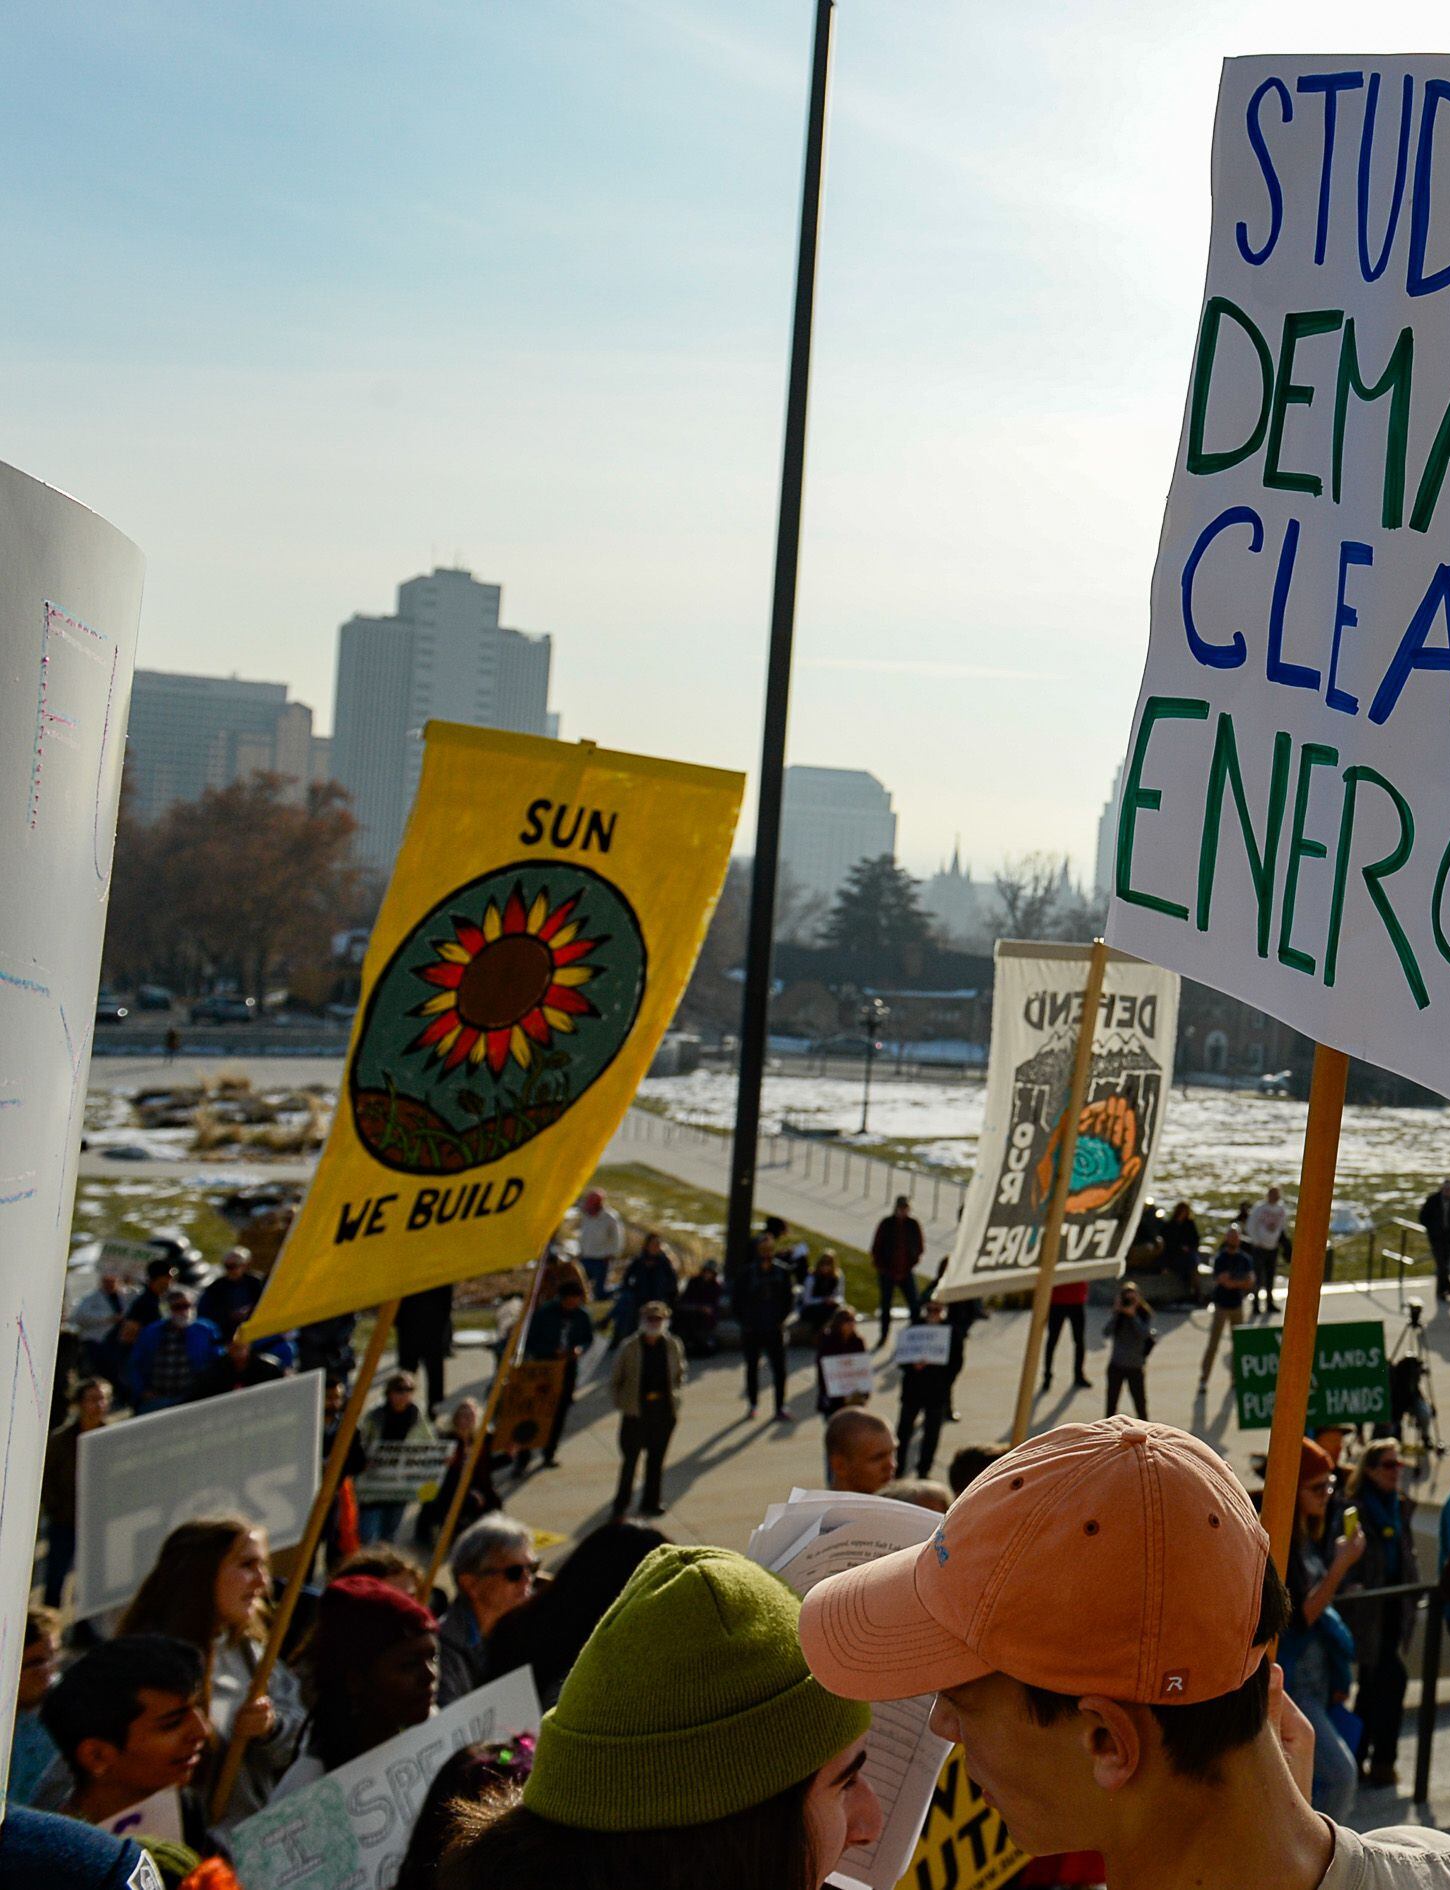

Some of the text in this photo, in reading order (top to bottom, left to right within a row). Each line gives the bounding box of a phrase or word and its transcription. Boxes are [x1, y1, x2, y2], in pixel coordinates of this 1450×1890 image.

[520, 799, 619, 853] SUN
[333, 1177, 525, 1246] WE BUILD
[1318, 1346, 1381, 1370] LANDS
[1325, 1386, 1384, 1415] HANDS
